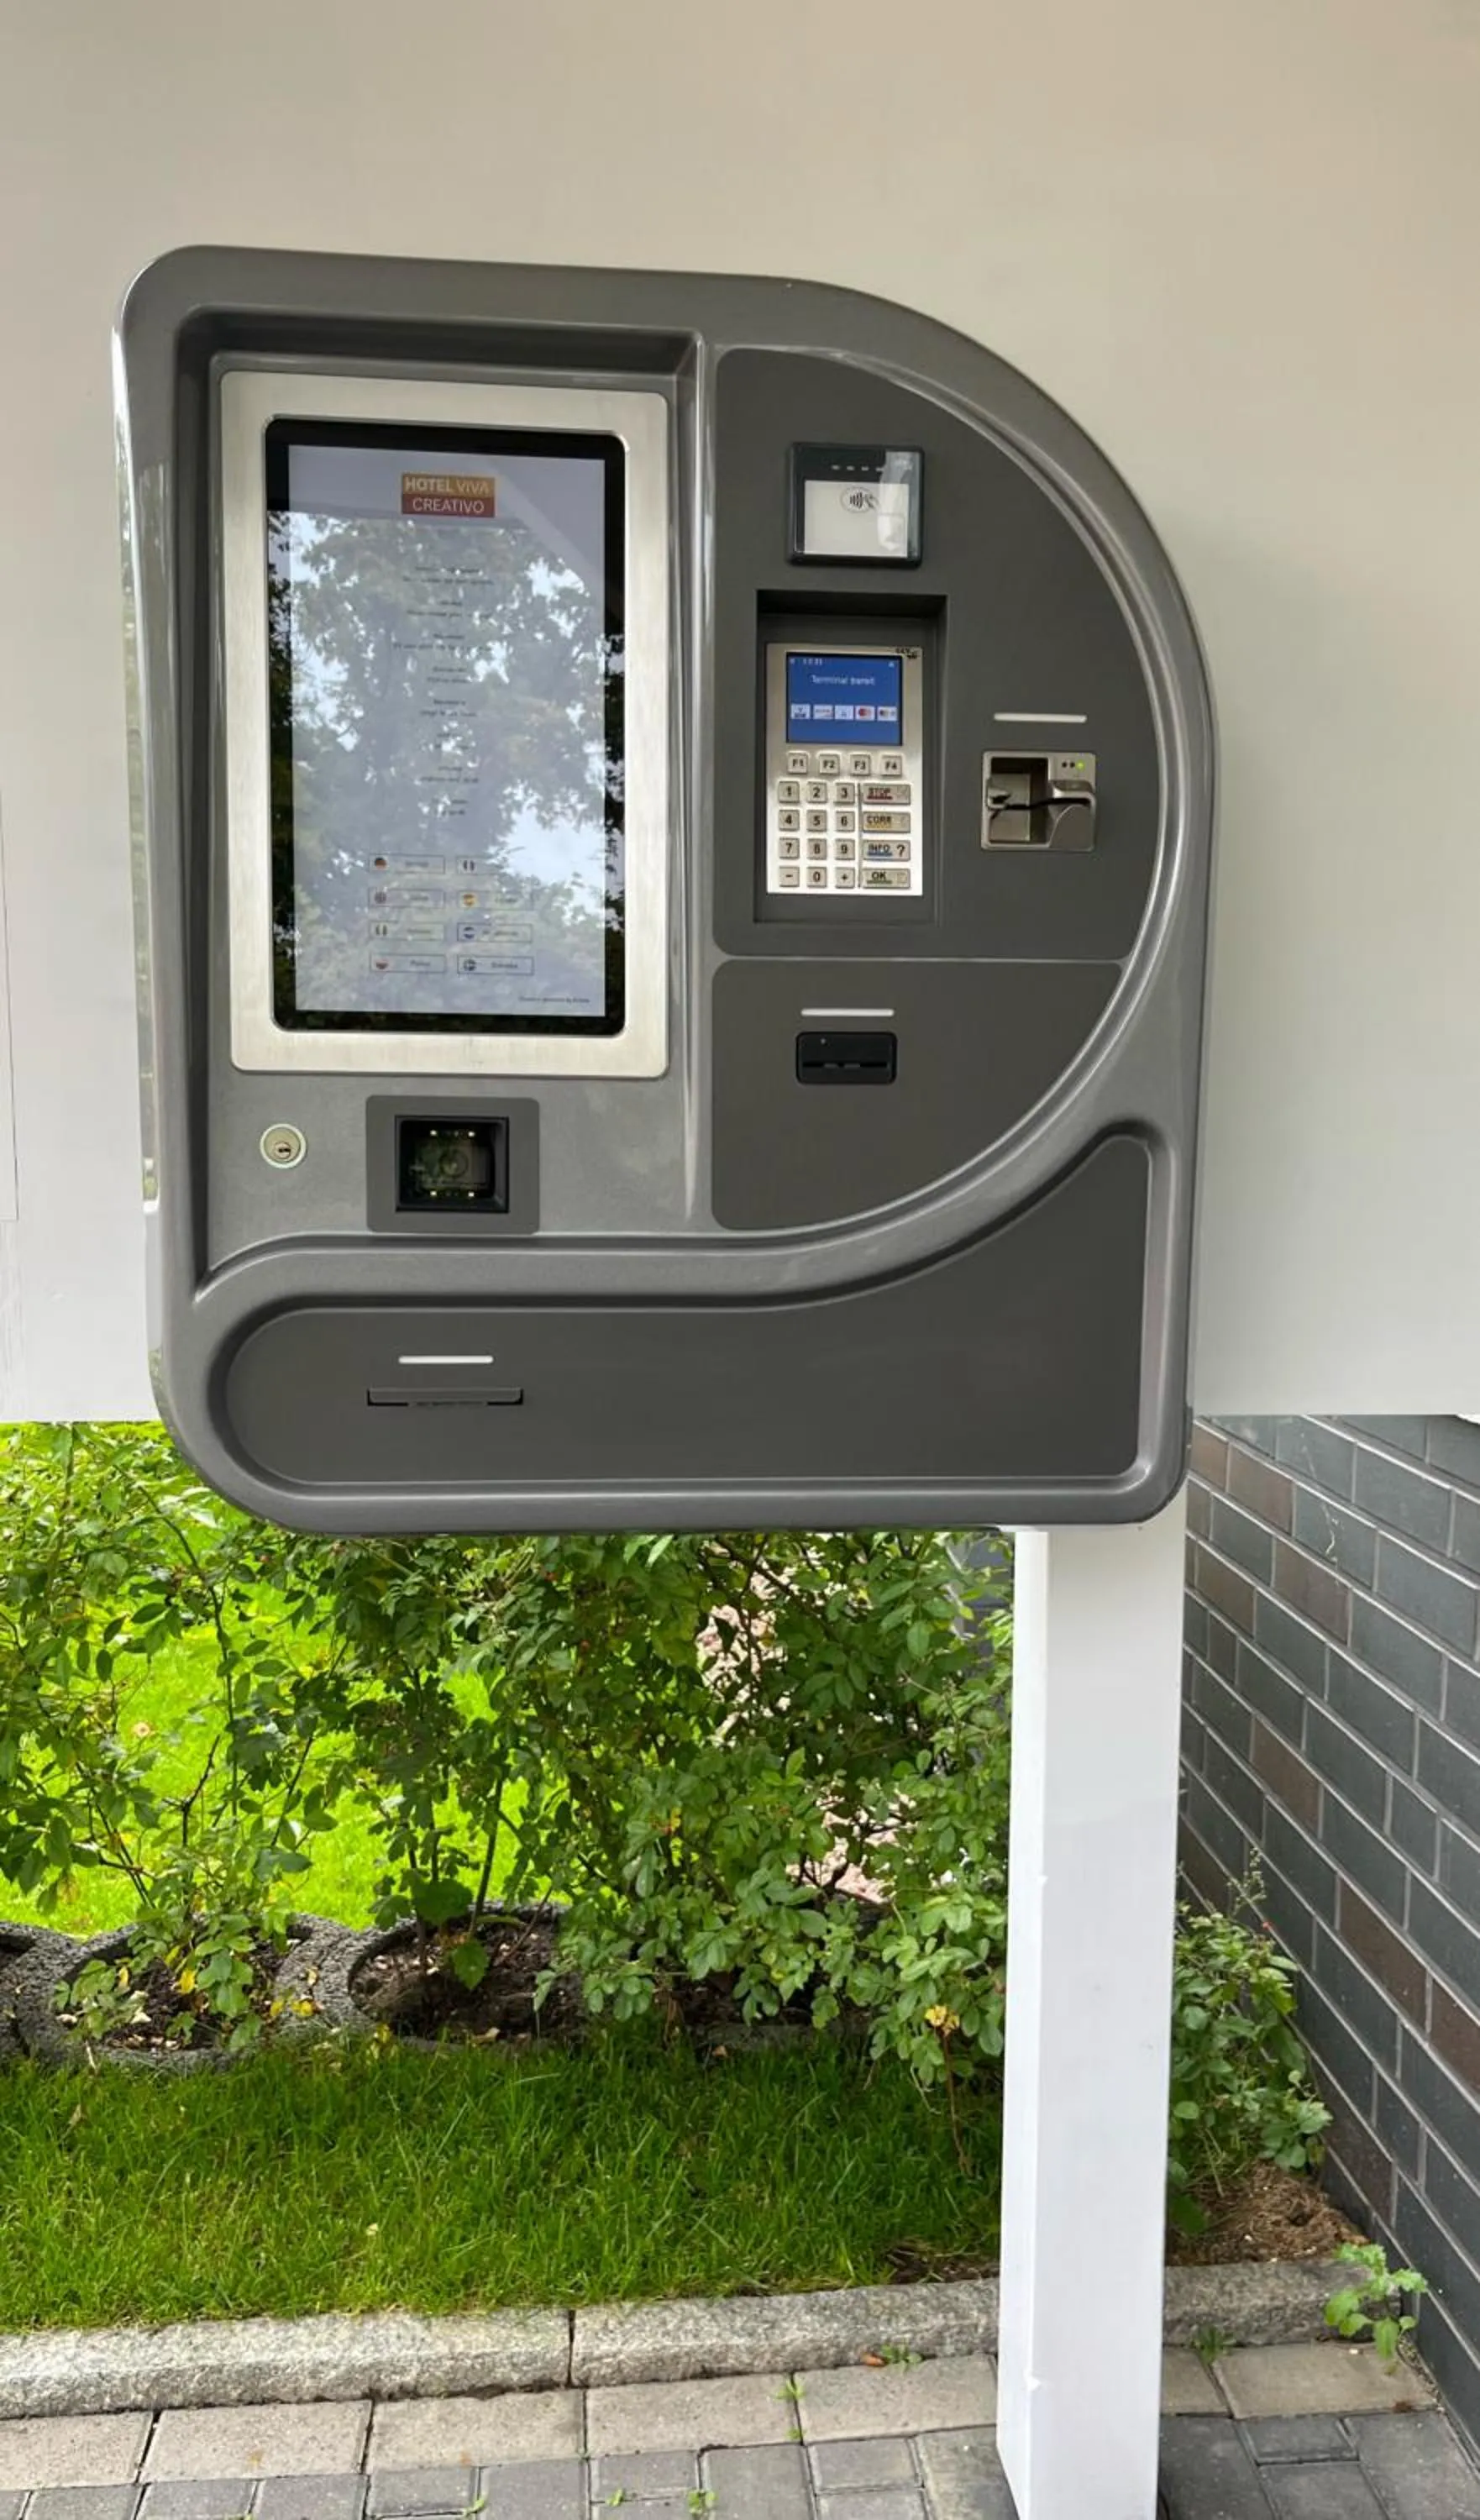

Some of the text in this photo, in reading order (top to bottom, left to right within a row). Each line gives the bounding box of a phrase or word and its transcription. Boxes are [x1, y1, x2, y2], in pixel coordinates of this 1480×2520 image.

[405, 476, 490, 495] HOTEL VIVA
[412, 497, 485, 514] CREATIVO
[792, 759, 804, 768] F1
[823, 760, 835, 769] F2
[854, 761, 866, 769] F3
[885, 761, 897, 770] F4
[785, 786, 792, 796] 1
[812, 787, 821, 797] 2
[841, 788, 848, 797] 3
[785, 815, 792, 825] 4
[813, 816, 821, 826] 5
[841, 816, 848, 826] 6
[785, 843, 793, 853] 7
[813, 843, 821, 854] 8
[841, 844, 848, 854] 9
[868, 844, 891, 853] INFO
[813, 871, 821, 882] 0
[871, 871, 887, 880] OK
